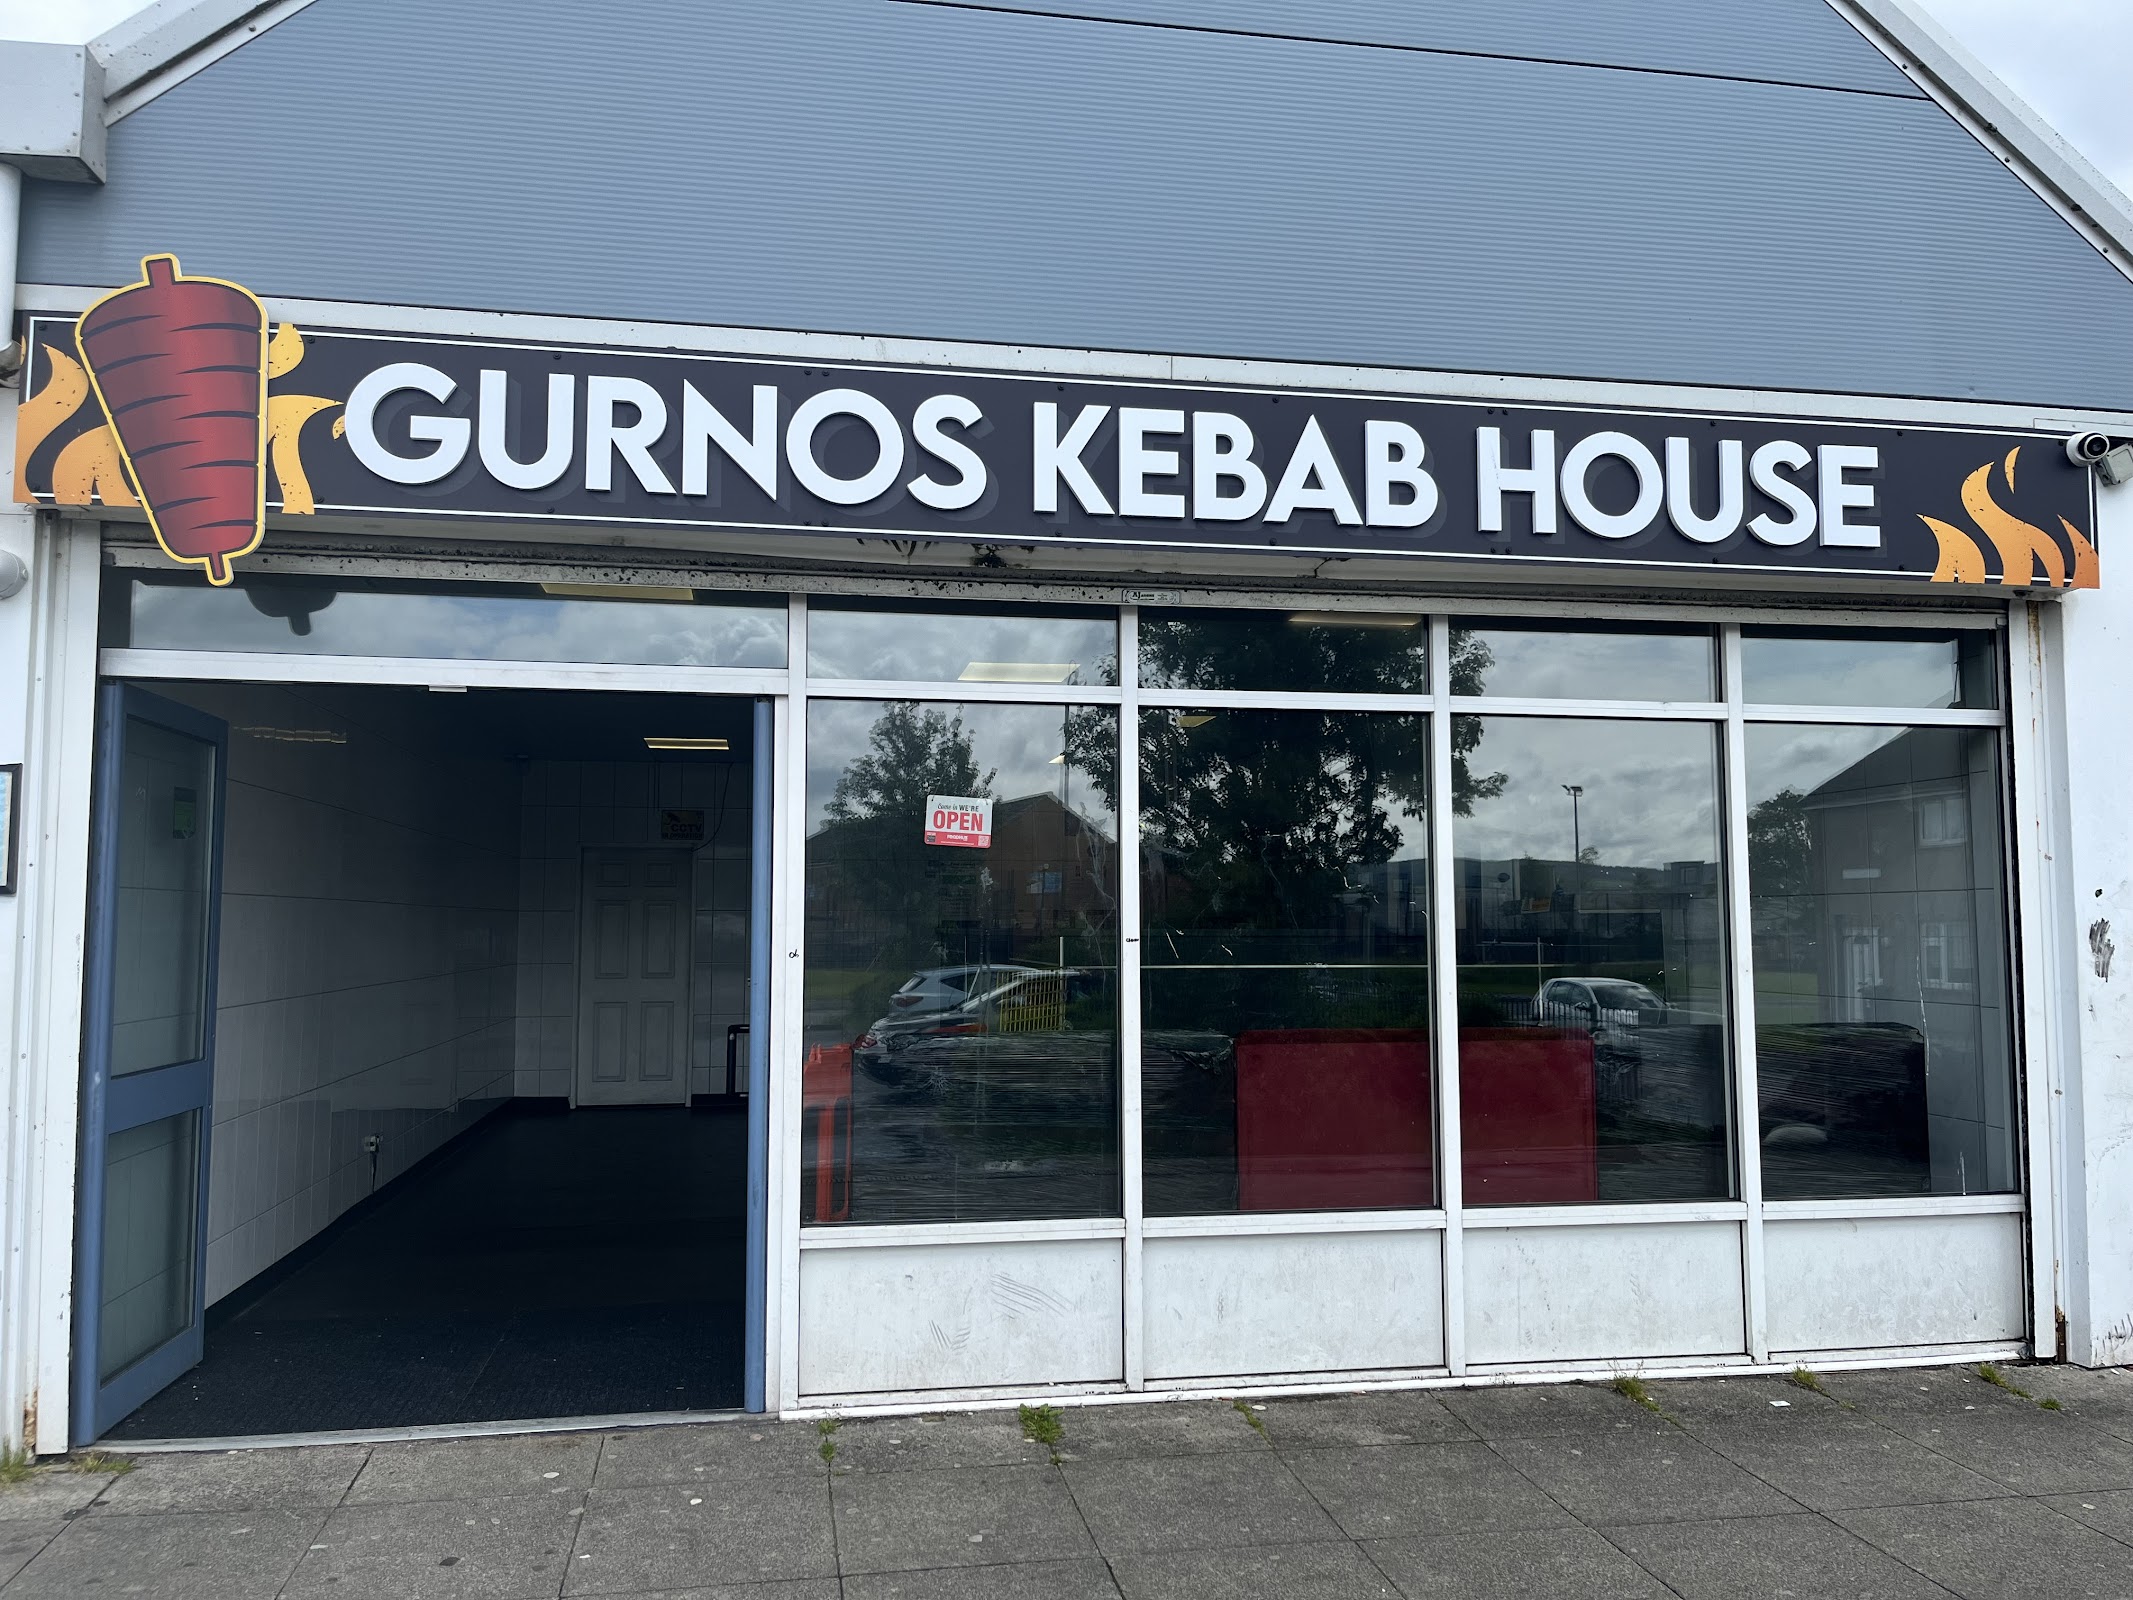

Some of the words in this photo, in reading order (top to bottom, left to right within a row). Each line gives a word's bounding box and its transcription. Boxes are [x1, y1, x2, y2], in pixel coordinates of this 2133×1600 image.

[341, 362, 988, 510] GURNOS
[1033, 401, 1440, 528] KEBAB
[1477, 426, 1883, 548] HOUSE
[958, 804, 979, 812] WE'RE
[933, 810, 983, 831] OPEN
